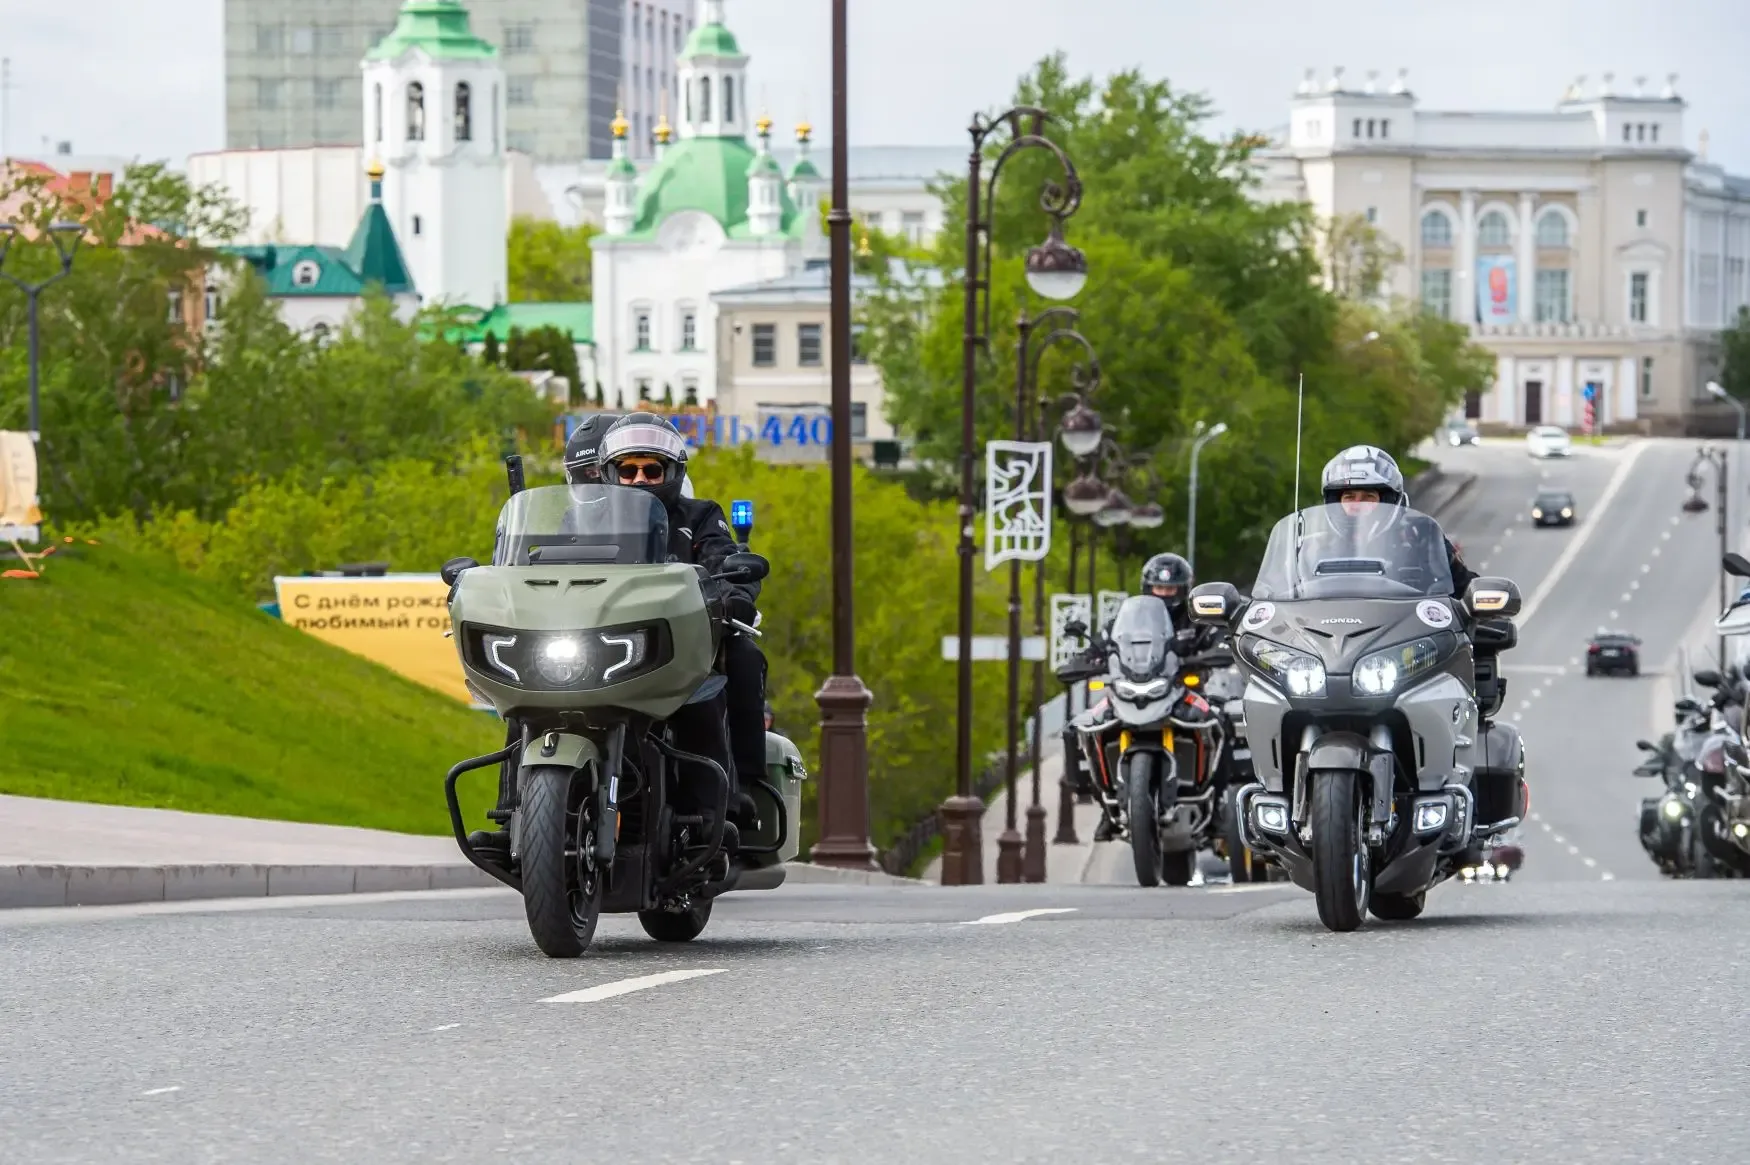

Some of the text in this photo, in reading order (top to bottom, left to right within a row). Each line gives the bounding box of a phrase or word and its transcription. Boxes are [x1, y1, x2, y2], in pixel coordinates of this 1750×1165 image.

[762, 415, 834, 446] 440
[575, 447, 596, 458] AIROH
[294, 594, 311, 609] С
[317, 594, 380, 610] днём
[294, 613, 409, 629] любимый
[1320, 617, 1363, 625] HONDA
